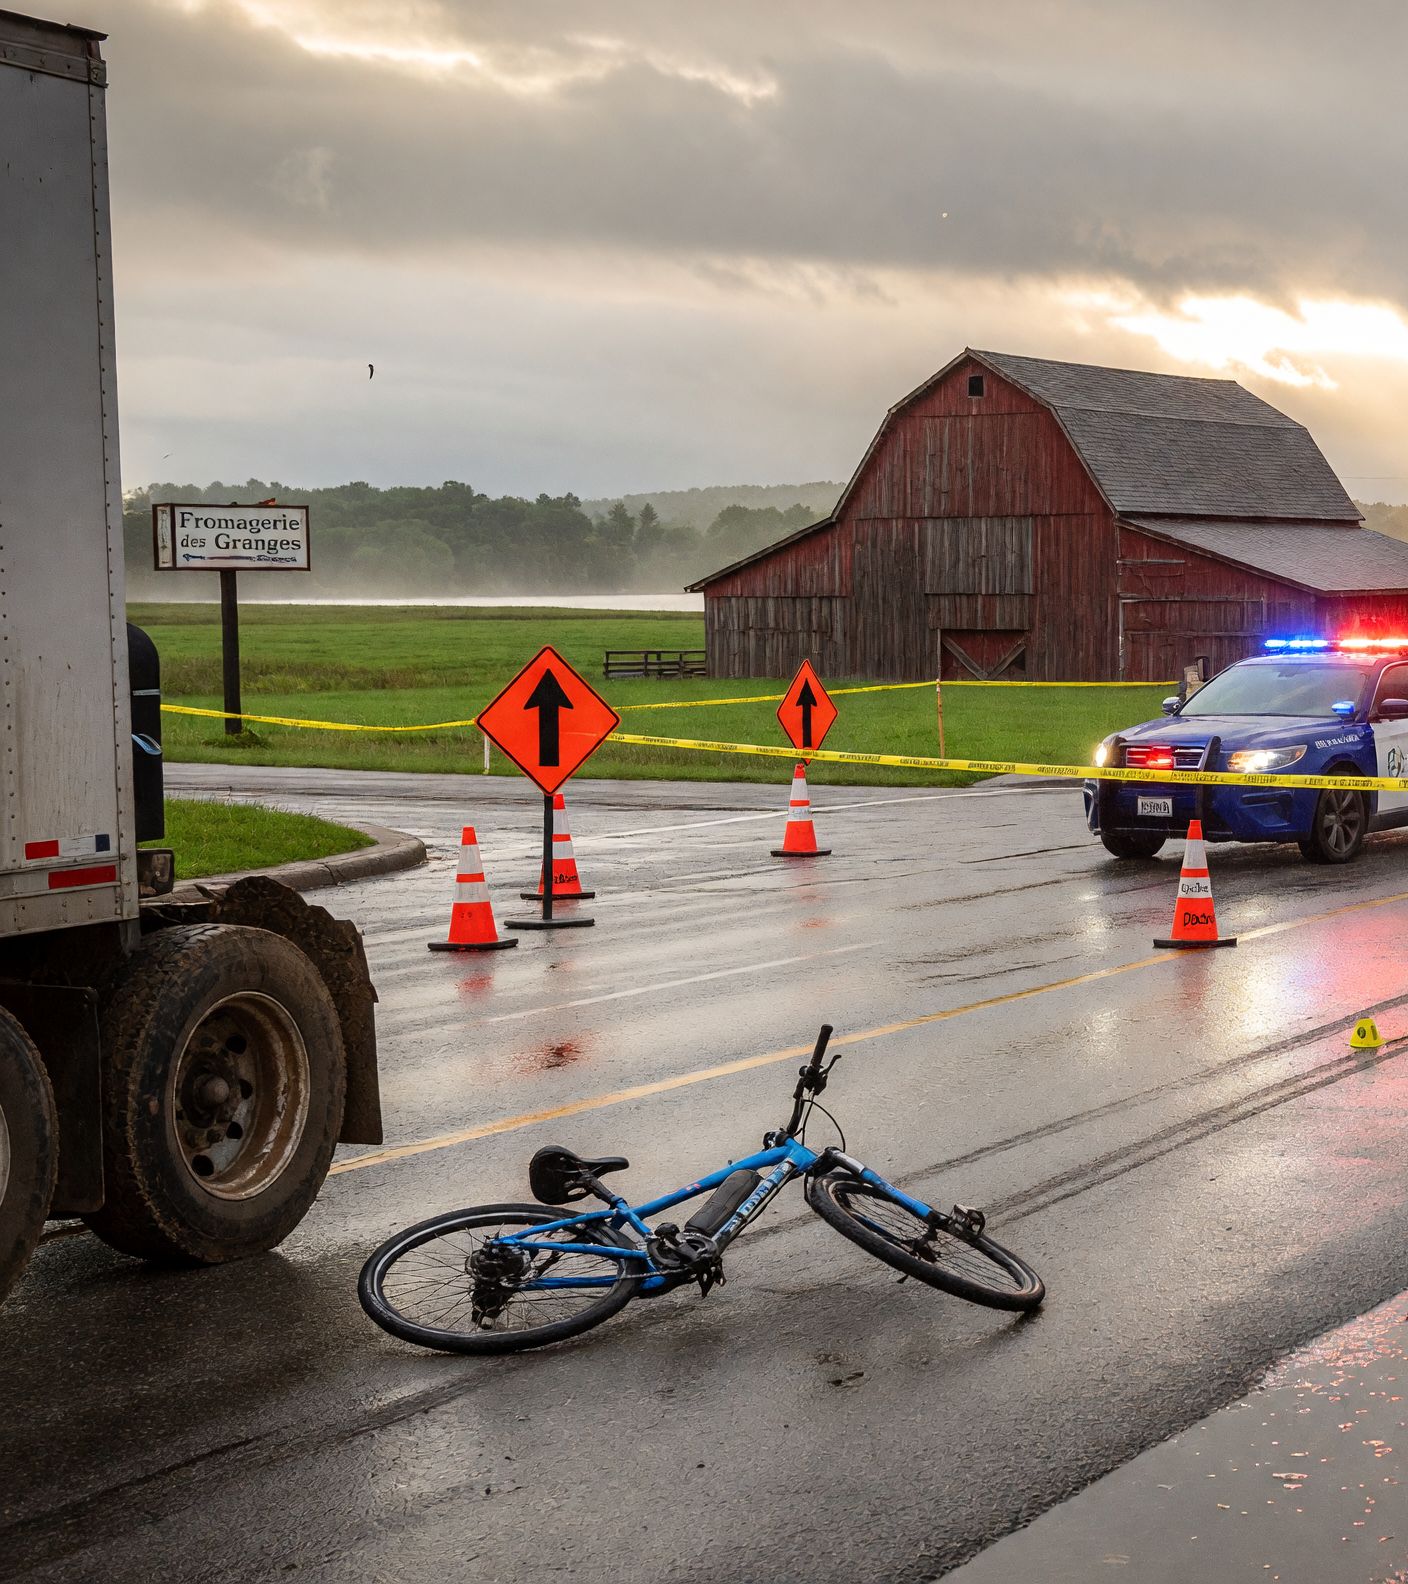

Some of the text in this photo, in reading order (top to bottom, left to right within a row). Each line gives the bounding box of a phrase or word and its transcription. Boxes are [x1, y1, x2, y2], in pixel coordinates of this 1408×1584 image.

[180, 511, 301, 534] Fromagerie
[180, 533, 302, 555] des Granges
